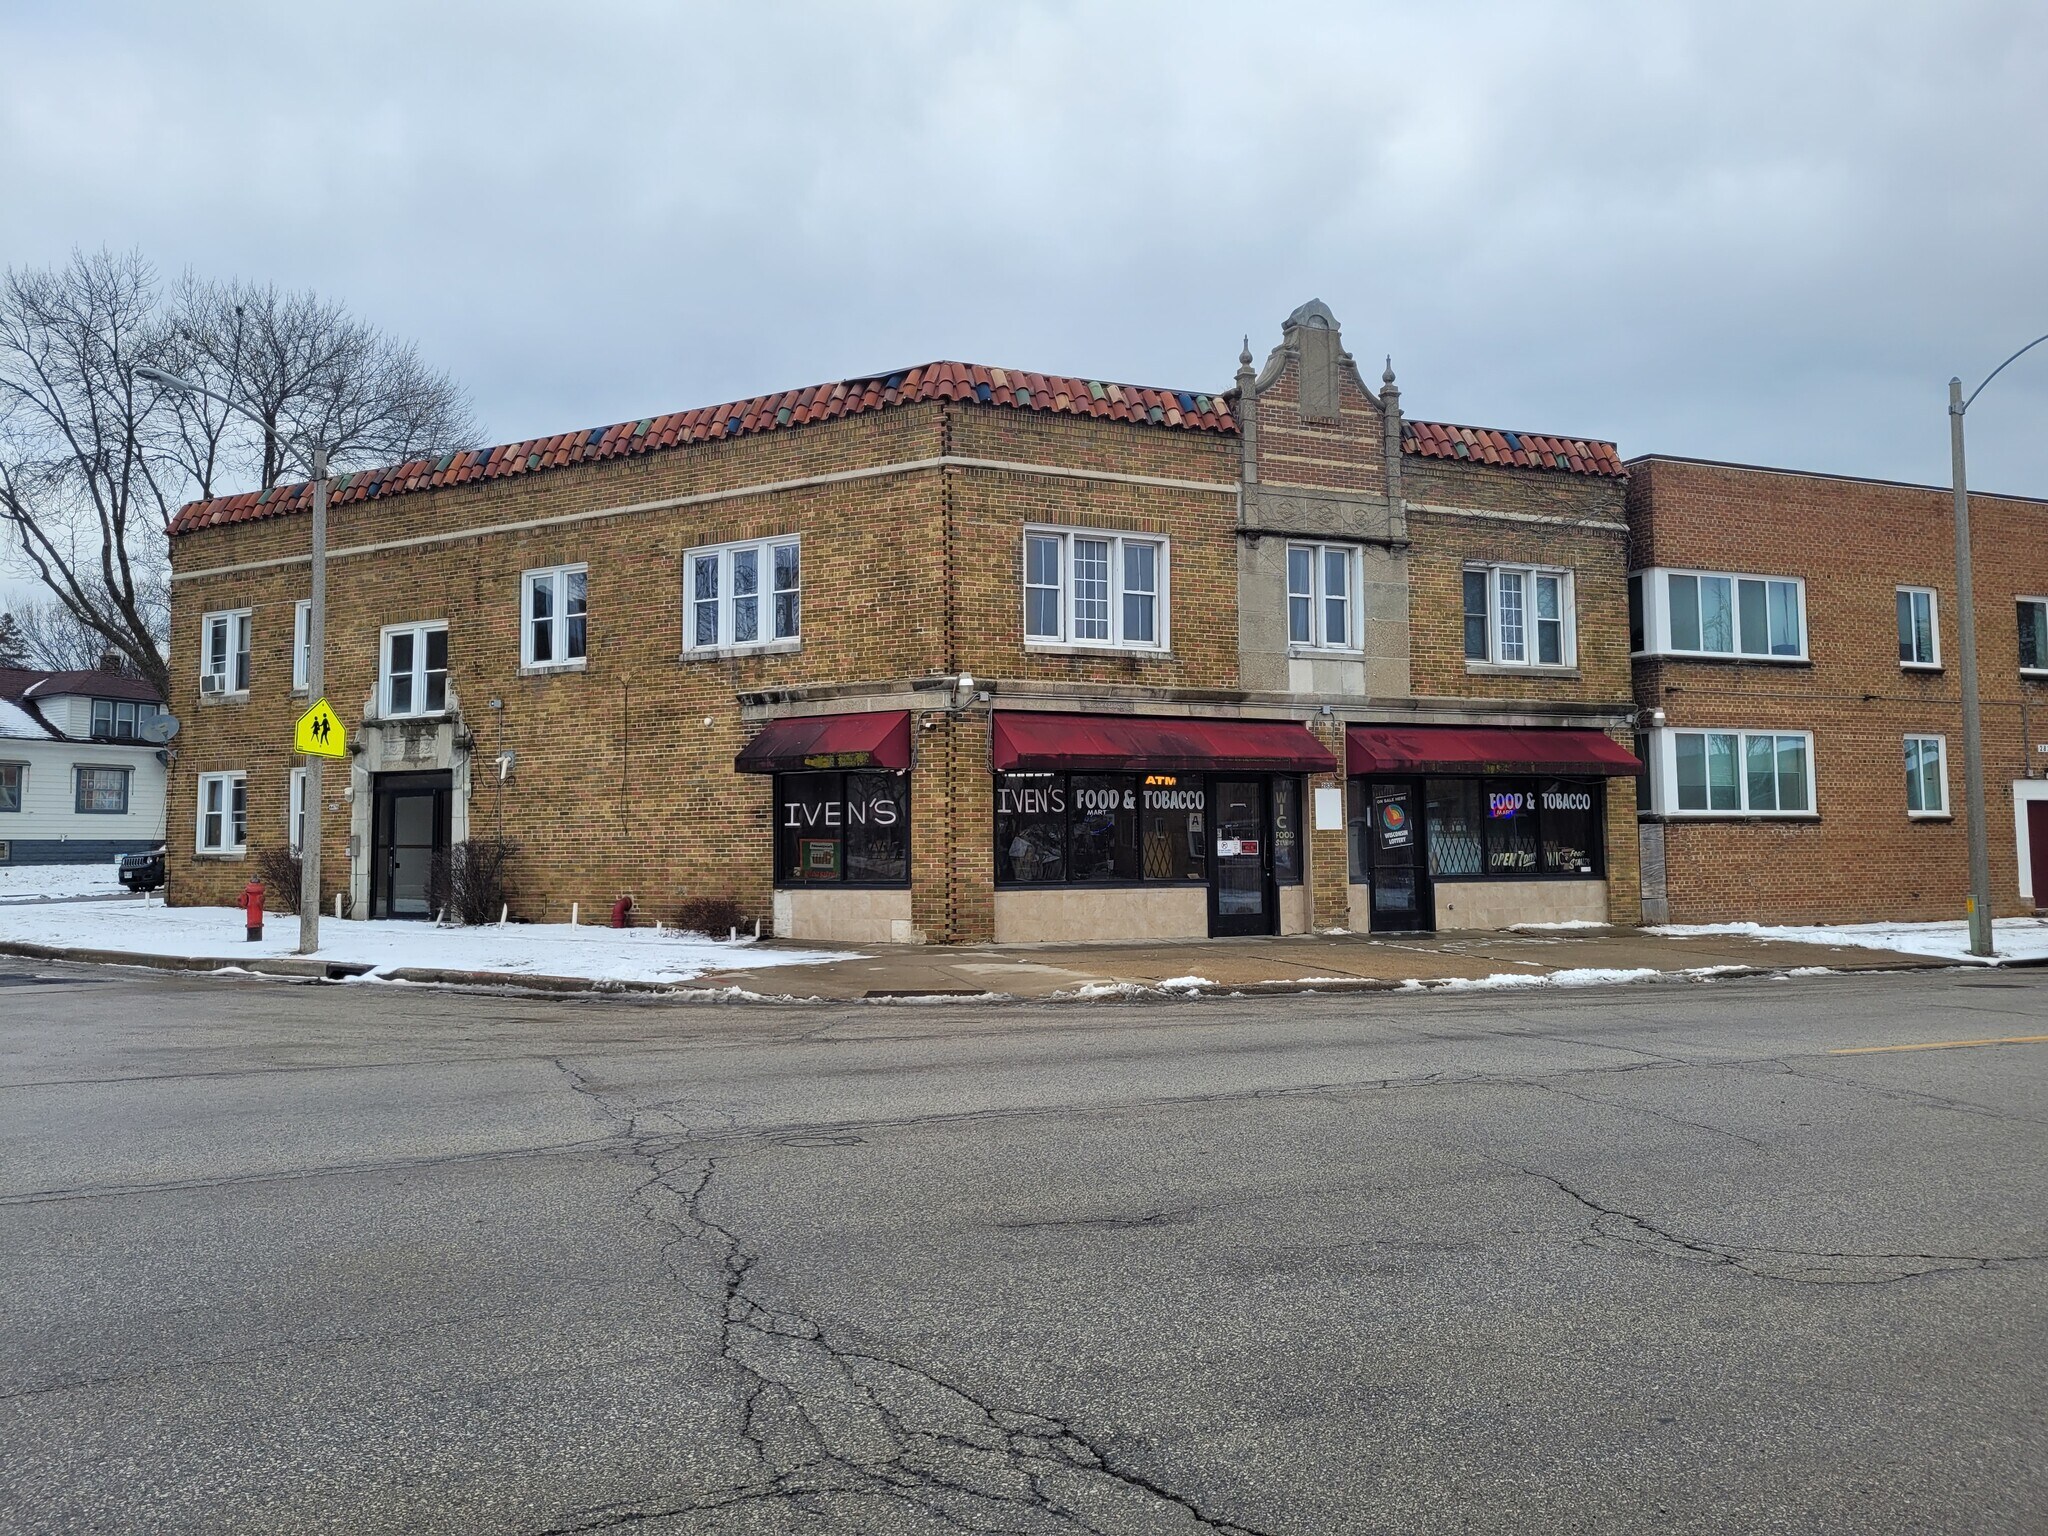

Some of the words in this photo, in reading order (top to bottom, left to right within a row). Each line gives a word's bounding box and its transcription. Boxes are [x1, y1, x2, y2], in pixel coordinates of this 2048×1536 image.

[1145, 775, 1176, 786] ATM
[997, 784, 1065, 813] IVEN'S
[1076, 789, 1120, 810] FOOD
[1123, 789, 1136, 810] &
[1143, 790, 1205, 810] TOBACCO
[1489, 792, 1523, 810] FOOD
[1526, 792, 1536, 810] &
[1541, 793, 1591, 810] TOBACCO
[784, 797, 897, 826] IVEN'S
[1191, 815, 1199, 826] A
[1275, 831, 1295, 839] FOOD
[1384, 830, 1408, 839] WISCONSIN
[1388, 837, 1407, 845] LOTTERY
[1491, 852, 1517, 867] OPEN
[1517, 850, 1525, 867] 7
